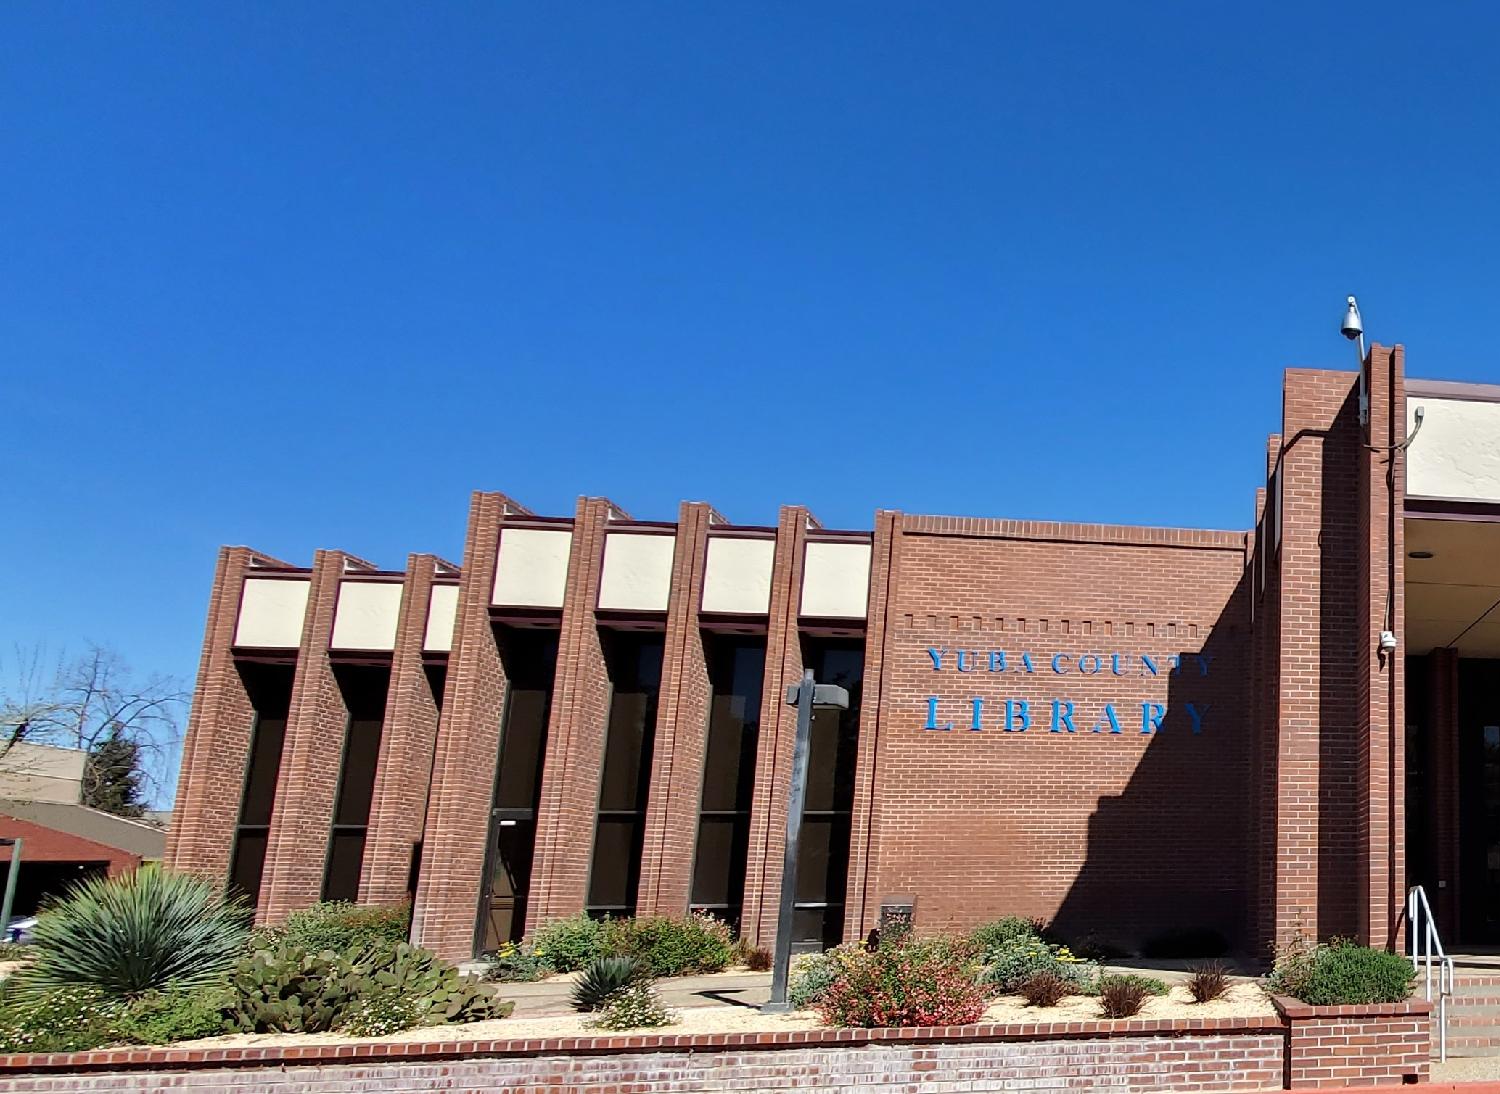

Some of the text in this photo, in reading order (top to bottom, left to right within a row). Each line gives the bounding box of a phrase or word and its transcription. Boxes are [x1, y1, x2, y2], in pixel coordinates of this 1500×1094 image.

[927, 648, 1215, 676] YUBA COUNTY
[925, 697, 1211, 734] LIBRARY
